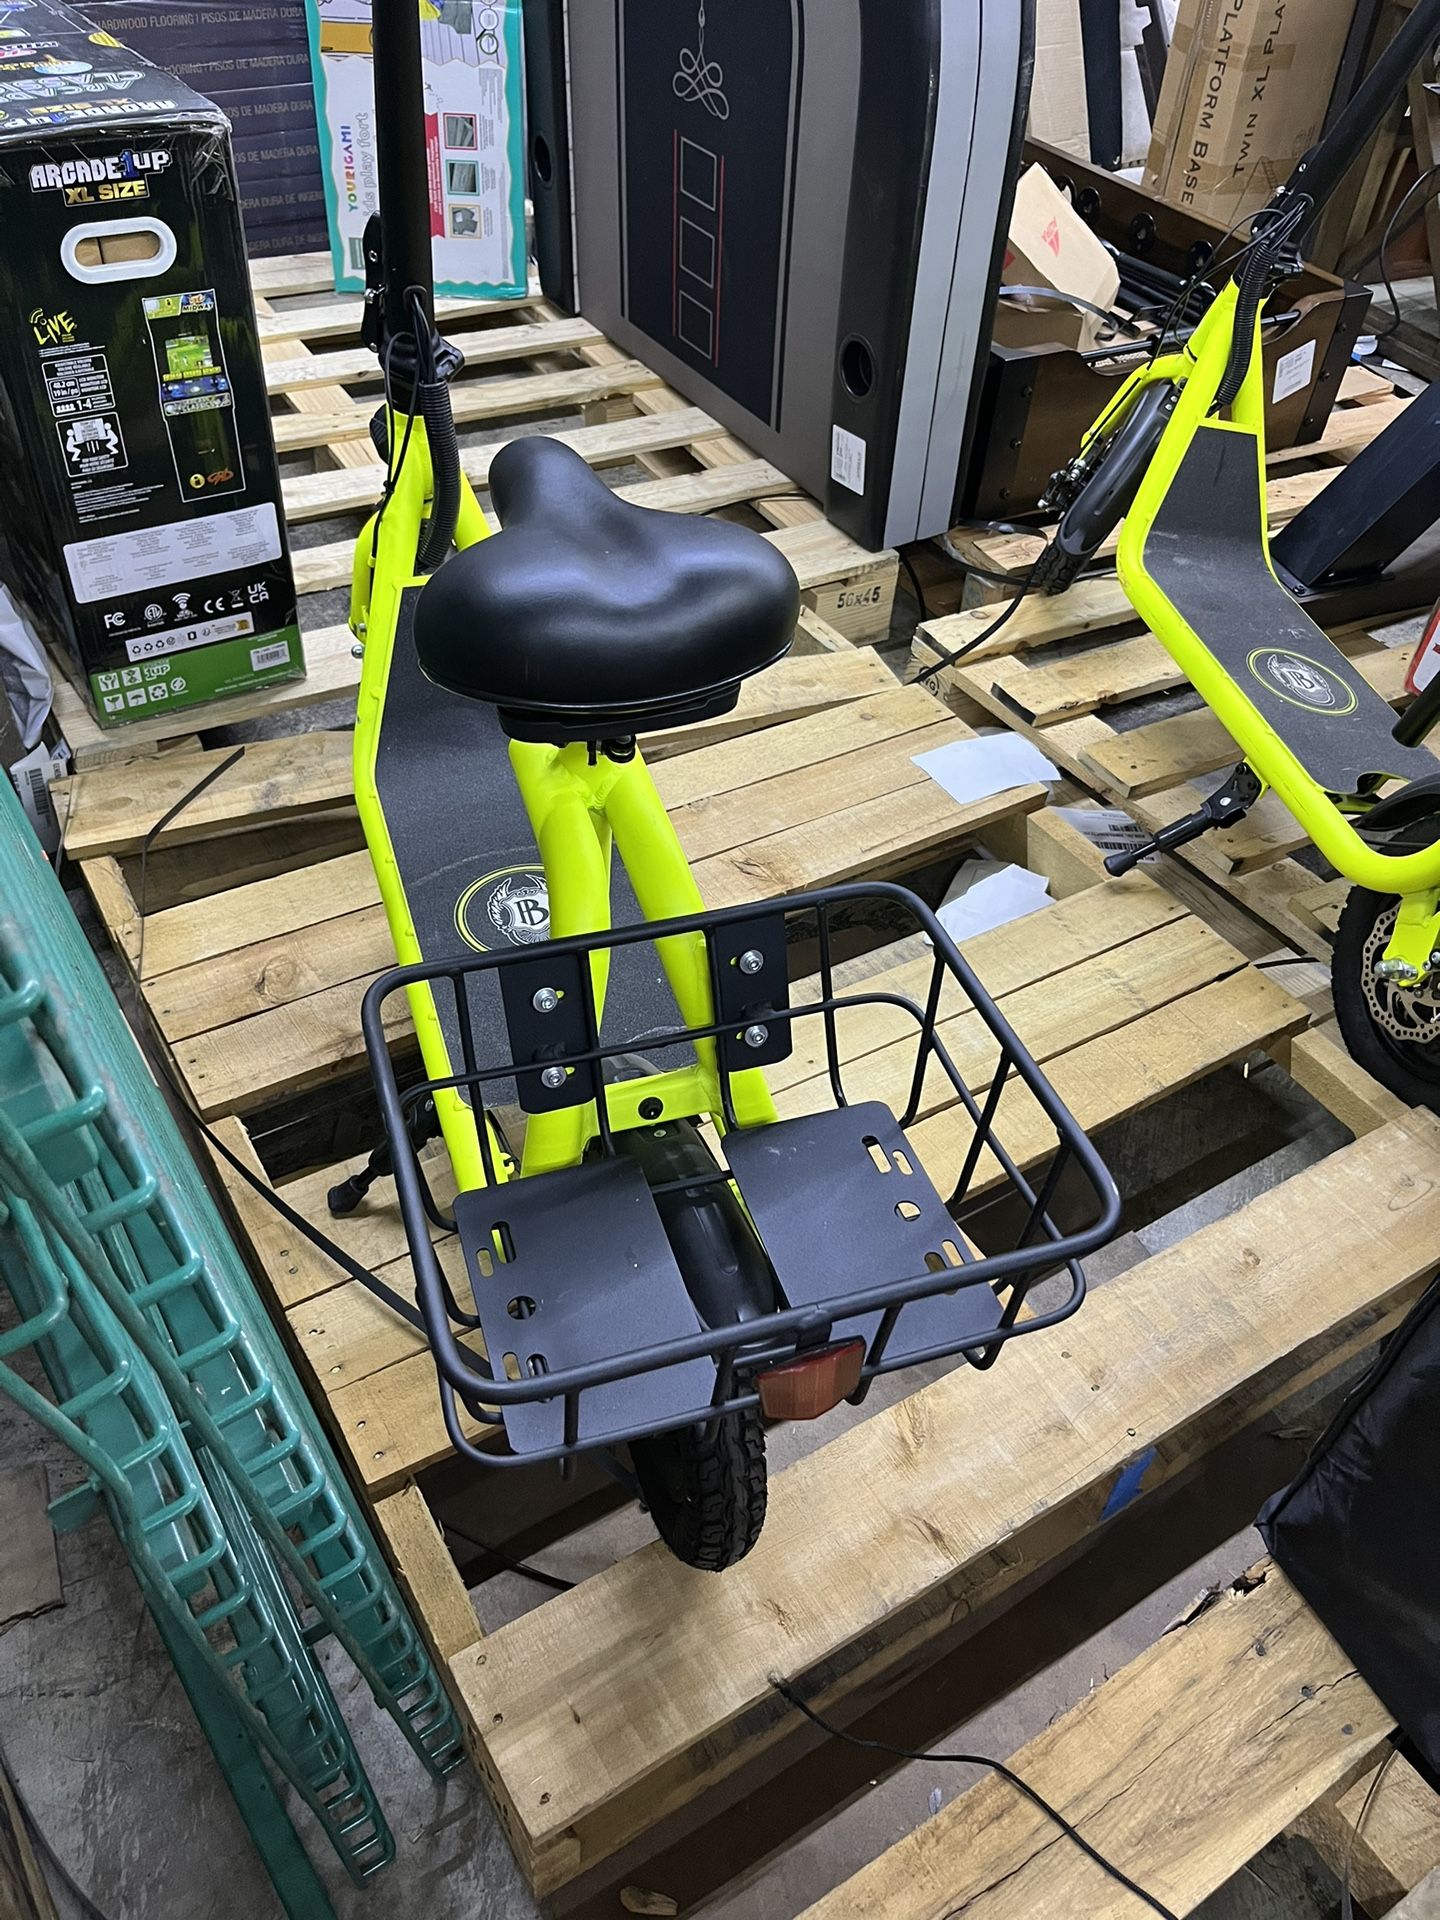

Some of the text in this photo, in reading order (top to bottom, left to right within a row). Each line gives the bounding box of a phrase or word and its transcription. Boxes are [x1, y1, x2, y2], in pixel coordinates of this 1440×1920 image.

[149, 13, 195, 28] FLOORING
[201, 11, 227, 24] PISOS
[229, 10, 241, 22] DE
[243, 7, 278, 20] MADERA
[280, 6, 305, 18] DURA
[1232, 0, 1286, 179] TWIN XL PLA
[355, 112, 371, 147] fort
[341, 125, 358, 212] YOURIGAMI
[360, 151, 377, 188] play
[1181, 140, 1208, 206] BASE
[65, 180, 147, 204] XL SIZE
[77, 398, 92, 411] 1-4
[247, 581, 267, 595] UK
[249, 592, 270, 604] CA
[204, 597, 225, 614] CE
